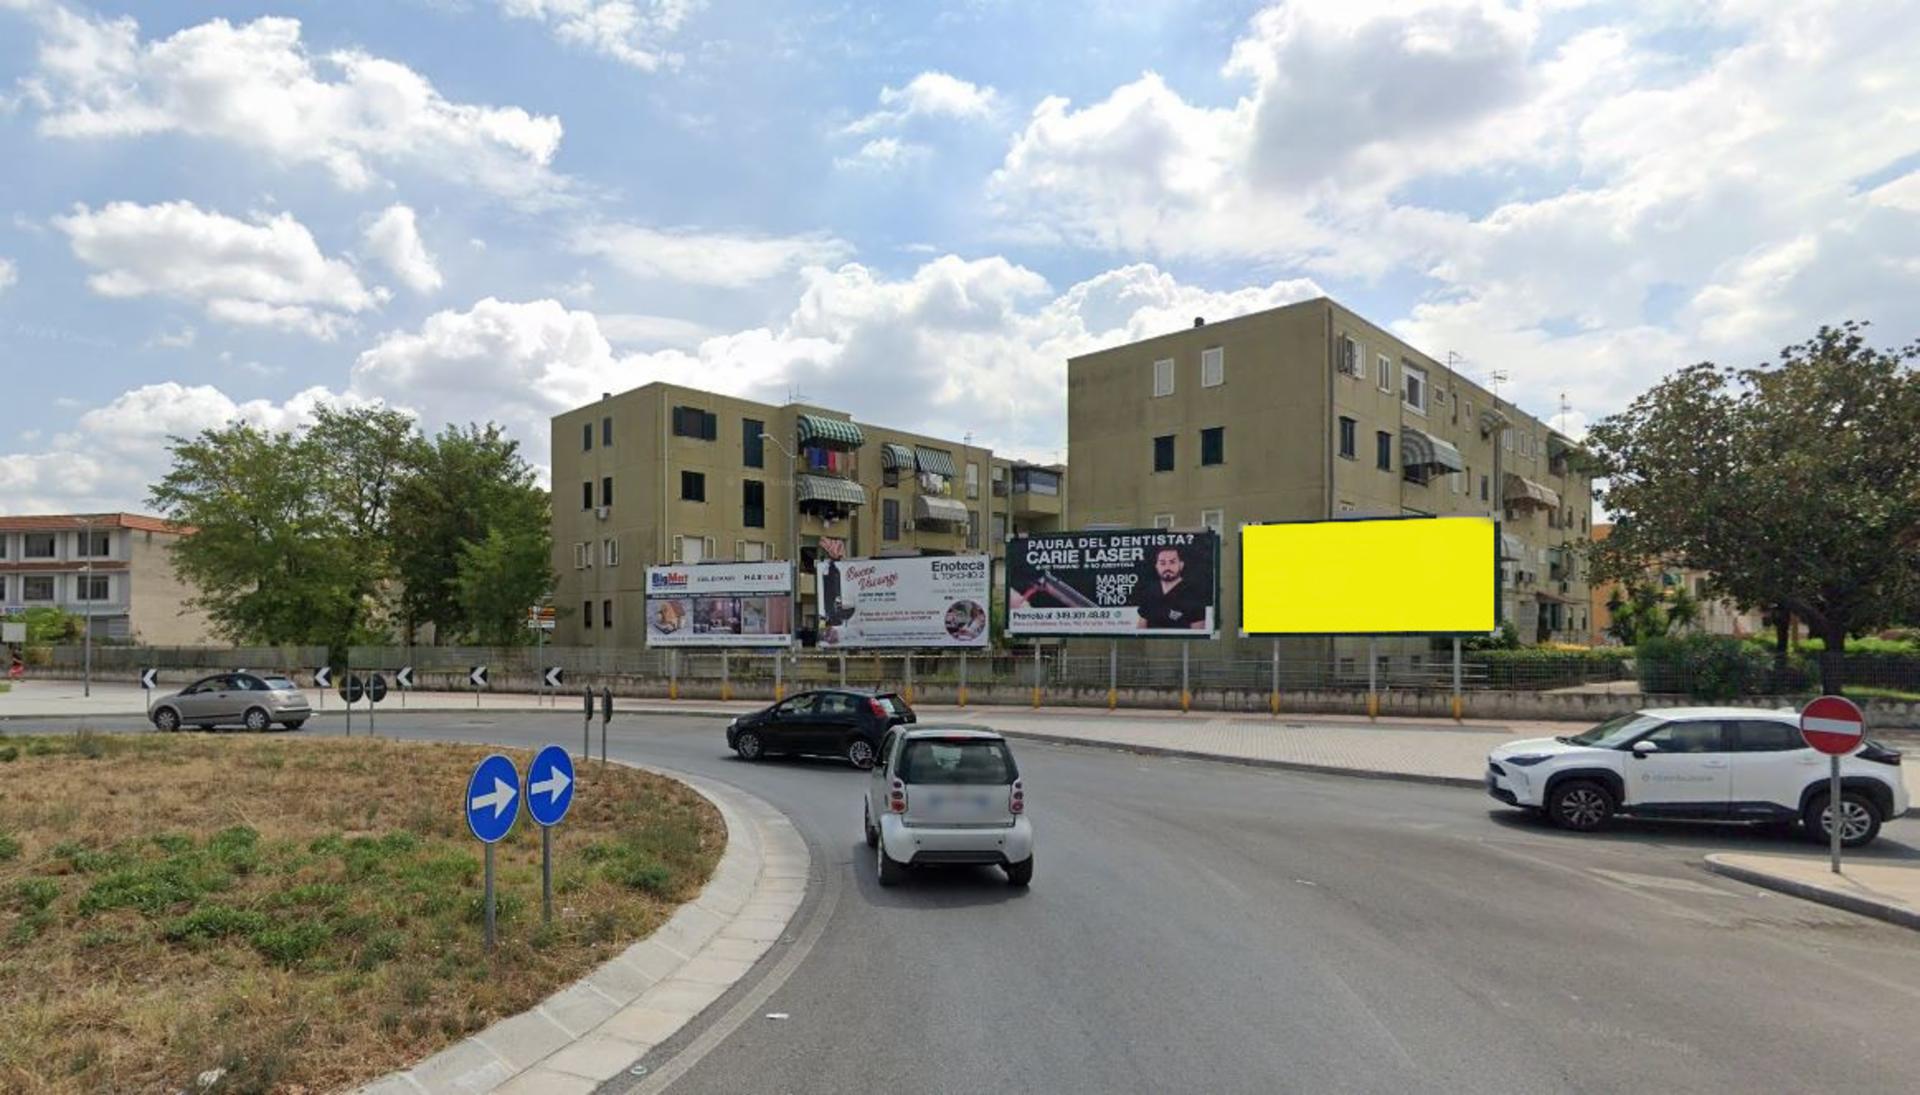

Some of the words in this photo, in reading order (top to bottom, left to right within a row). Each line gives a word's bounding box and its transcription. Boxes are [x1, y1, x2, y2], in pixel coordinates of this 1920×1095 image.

[1028, 539, 1074, 550] PAURA
[1079, 538, 1107, 548] DEL
[1111, 534, 1194, 548] DENTISTA?
[1026, 550, 1079, 564] CARIE
[1085, 548, 1144, 562] LASER
[931, 560, 985, 572] Enoteca
[652, 572, 688, 587] BigMat
[979, 571, 985, 579] 2
[1096, 574, 1139, 584] MARIO
[1096, 584, 1135, 594] SCHET
[1097, 594, 1127, 605] TINO
